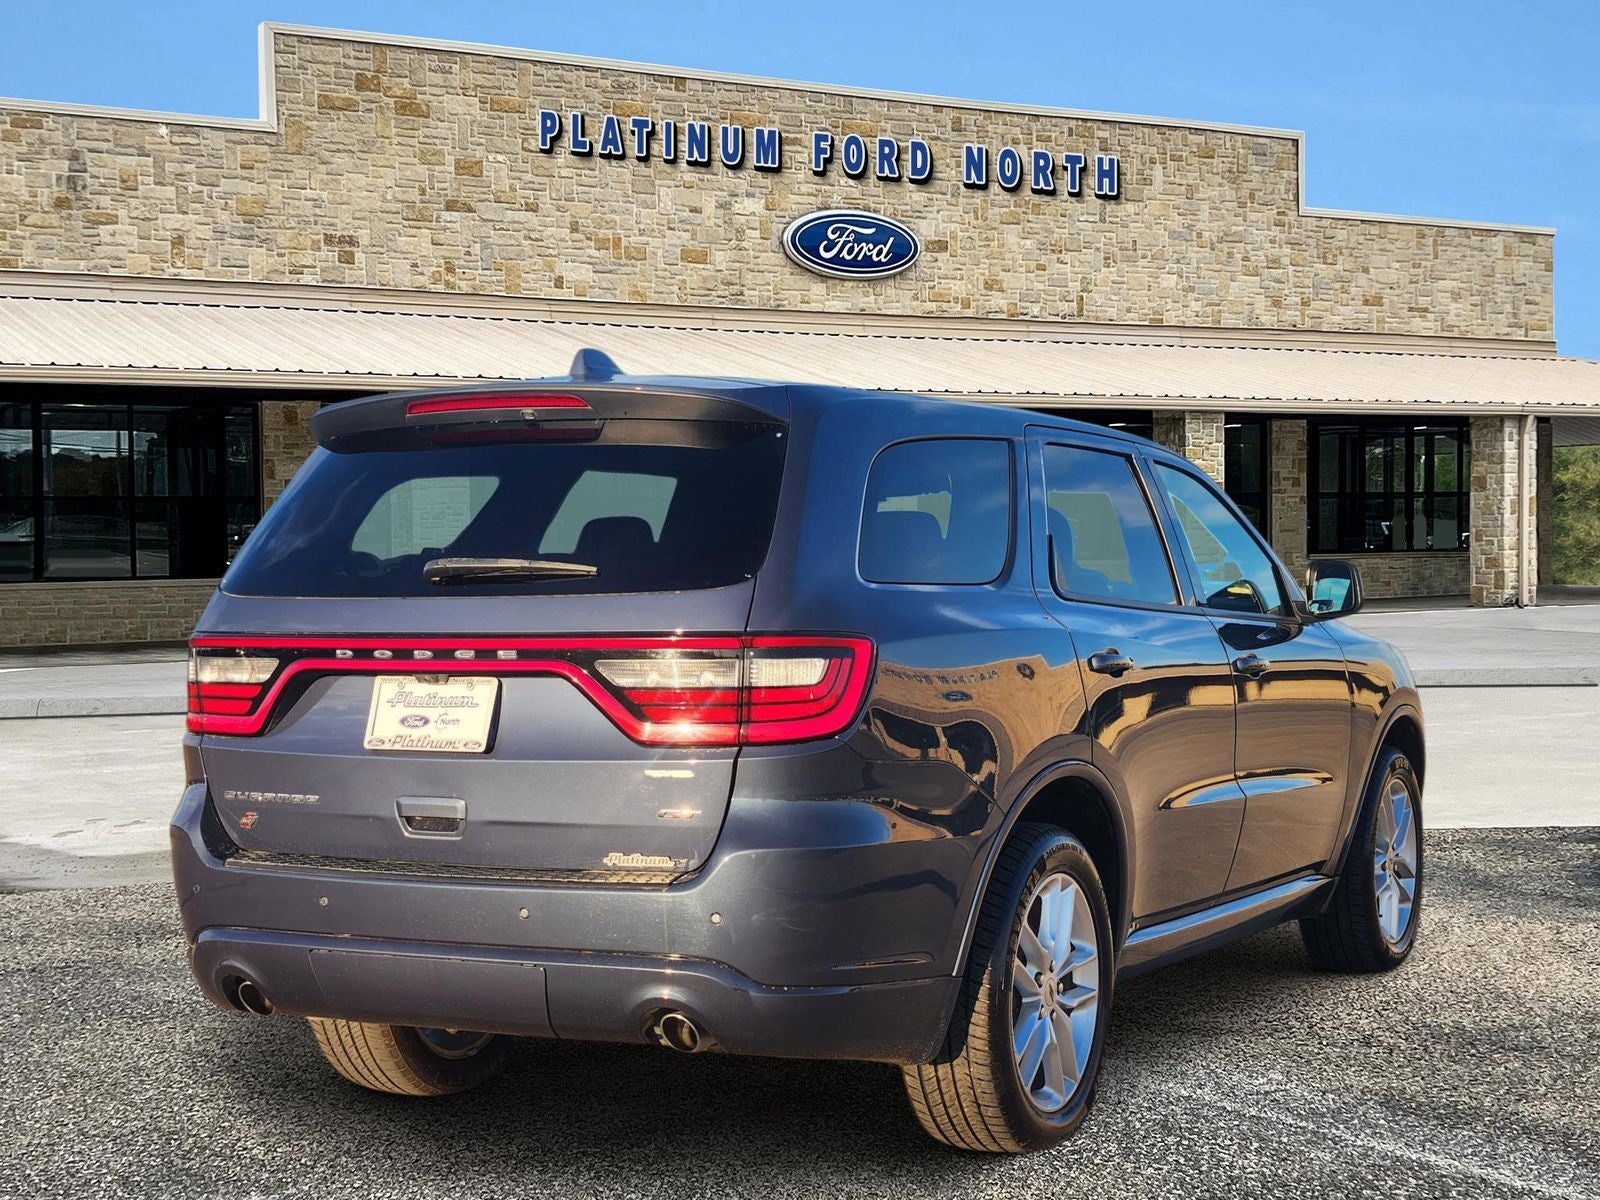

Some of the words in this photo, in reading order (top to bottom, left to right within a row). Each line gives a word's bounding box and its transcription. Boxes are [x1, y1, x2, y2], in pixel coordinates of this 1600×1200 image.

[538, 109, 782, 171] PLATINUM
[812, 132, 934, 184] FORD
[963, 144, 1121, 199] NORTH
[818, 223, 894, 264] Ford
[335, 649, 518, 660] DODGE
[386, 691, 480, 708] Platinum
[403, 715, 427, 727] Ford
[440, 717, 460, 726] North
[391, 735, 460, 749] Platinum
[602, 852, 676, 867] Platinum
